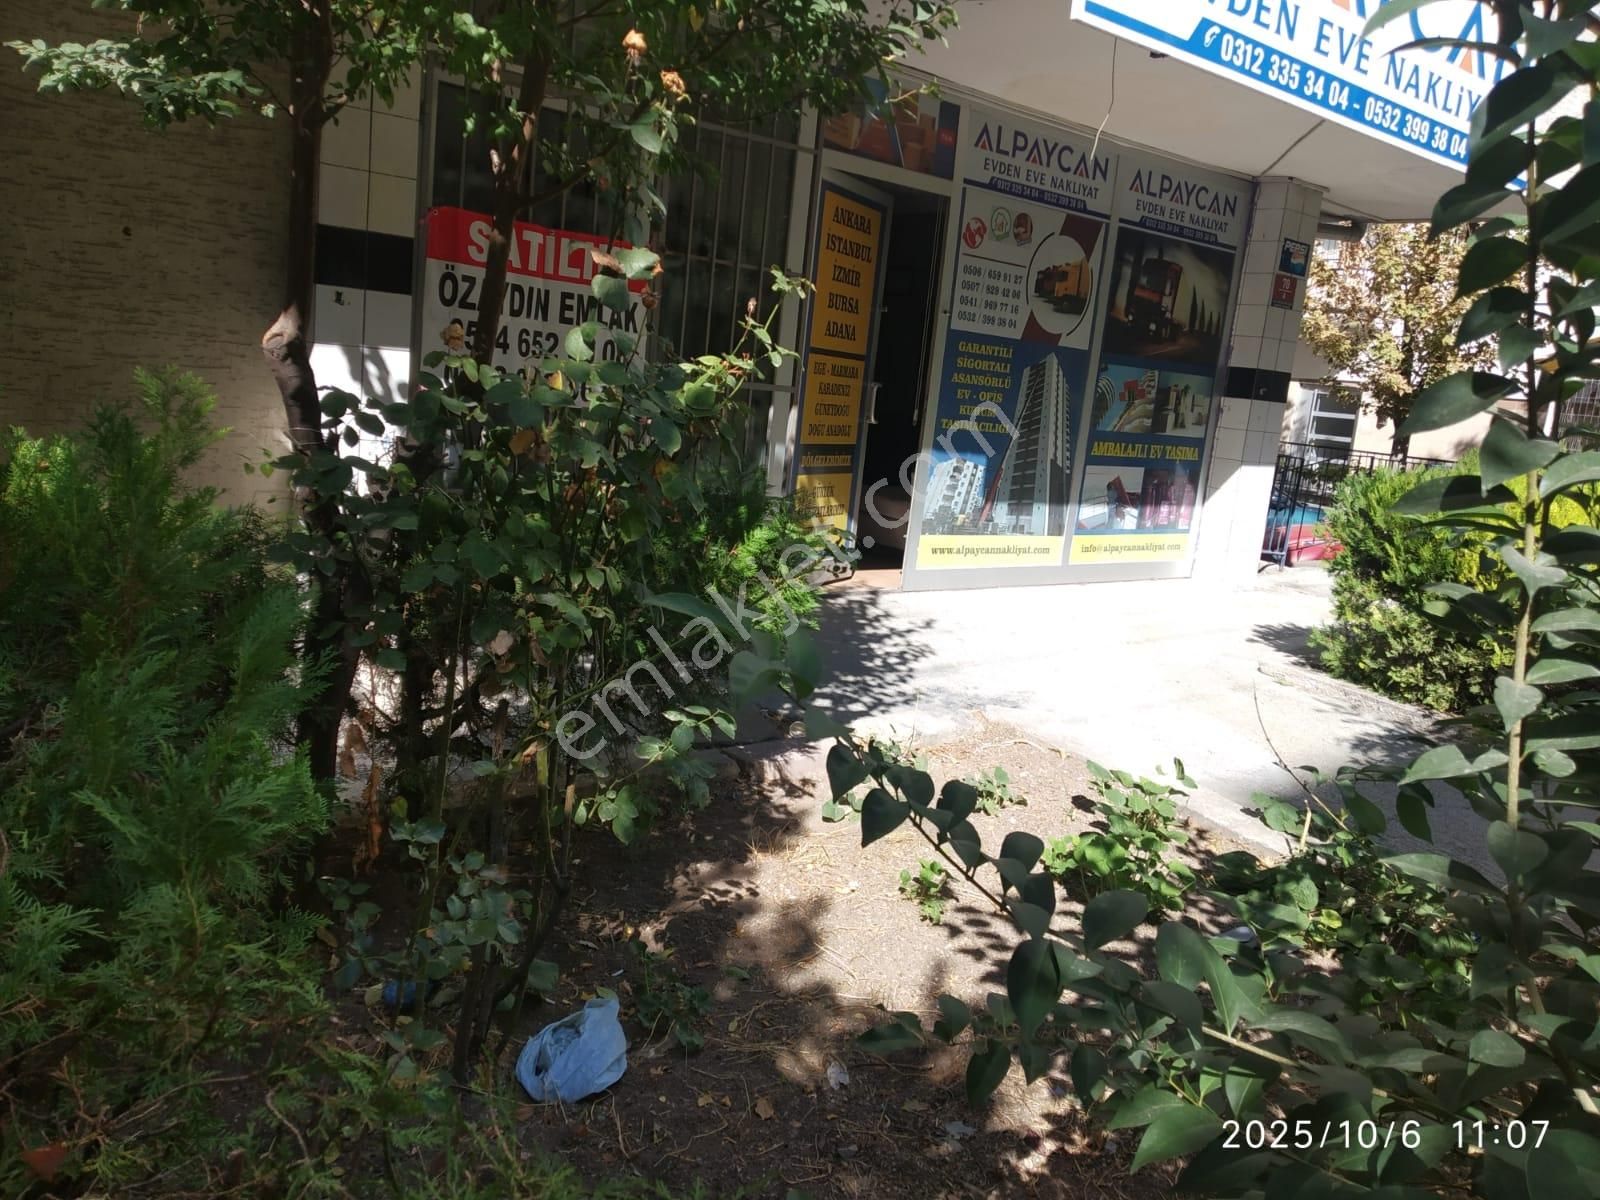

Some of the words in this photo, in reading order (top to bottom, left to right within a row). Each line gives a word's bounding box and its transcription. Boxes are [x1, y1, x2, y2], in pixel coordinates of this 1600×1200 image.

[1314, 16, 1373, 75] EVE
[1220, 33, 1265, 75] 0312
[1268, 54, 1301, 89] 335
[1303, 70, 1325, 98] 34
[1328, 80, 1350, 110] 04
[1364, 97, 1401, 133] 0532
[1403, 113, 1430, 144] 399
[1431, 127, 1448, 151] 38
[1451, 136, 1468, 159] 04
[974, 122, 1110, 183] ALPAYCAN
[984, 157, 1022, 179] EVDEN
[1025, 169, 1047, 185] EVE
[1129, 168, 1238, 217] ALPAYCAN
[832, 206, 871, 235] ANKARA
[1136, 199, 1167, 217] EVDEN
[1169, 208, 1186, 222] EVE
[467, 220, 632, 282] SATILI
[438, 264, 551, 323] ÖZDIN
[559, 291, 639, 333] EMLAK
[828, 292, 859, 315] BURSA
[517, 328, 560, 360] 652
[825, 320, 856, 342] ADANA
[957, 389, 971, 400] EV
[1150, 444, 1164, 459] EV
